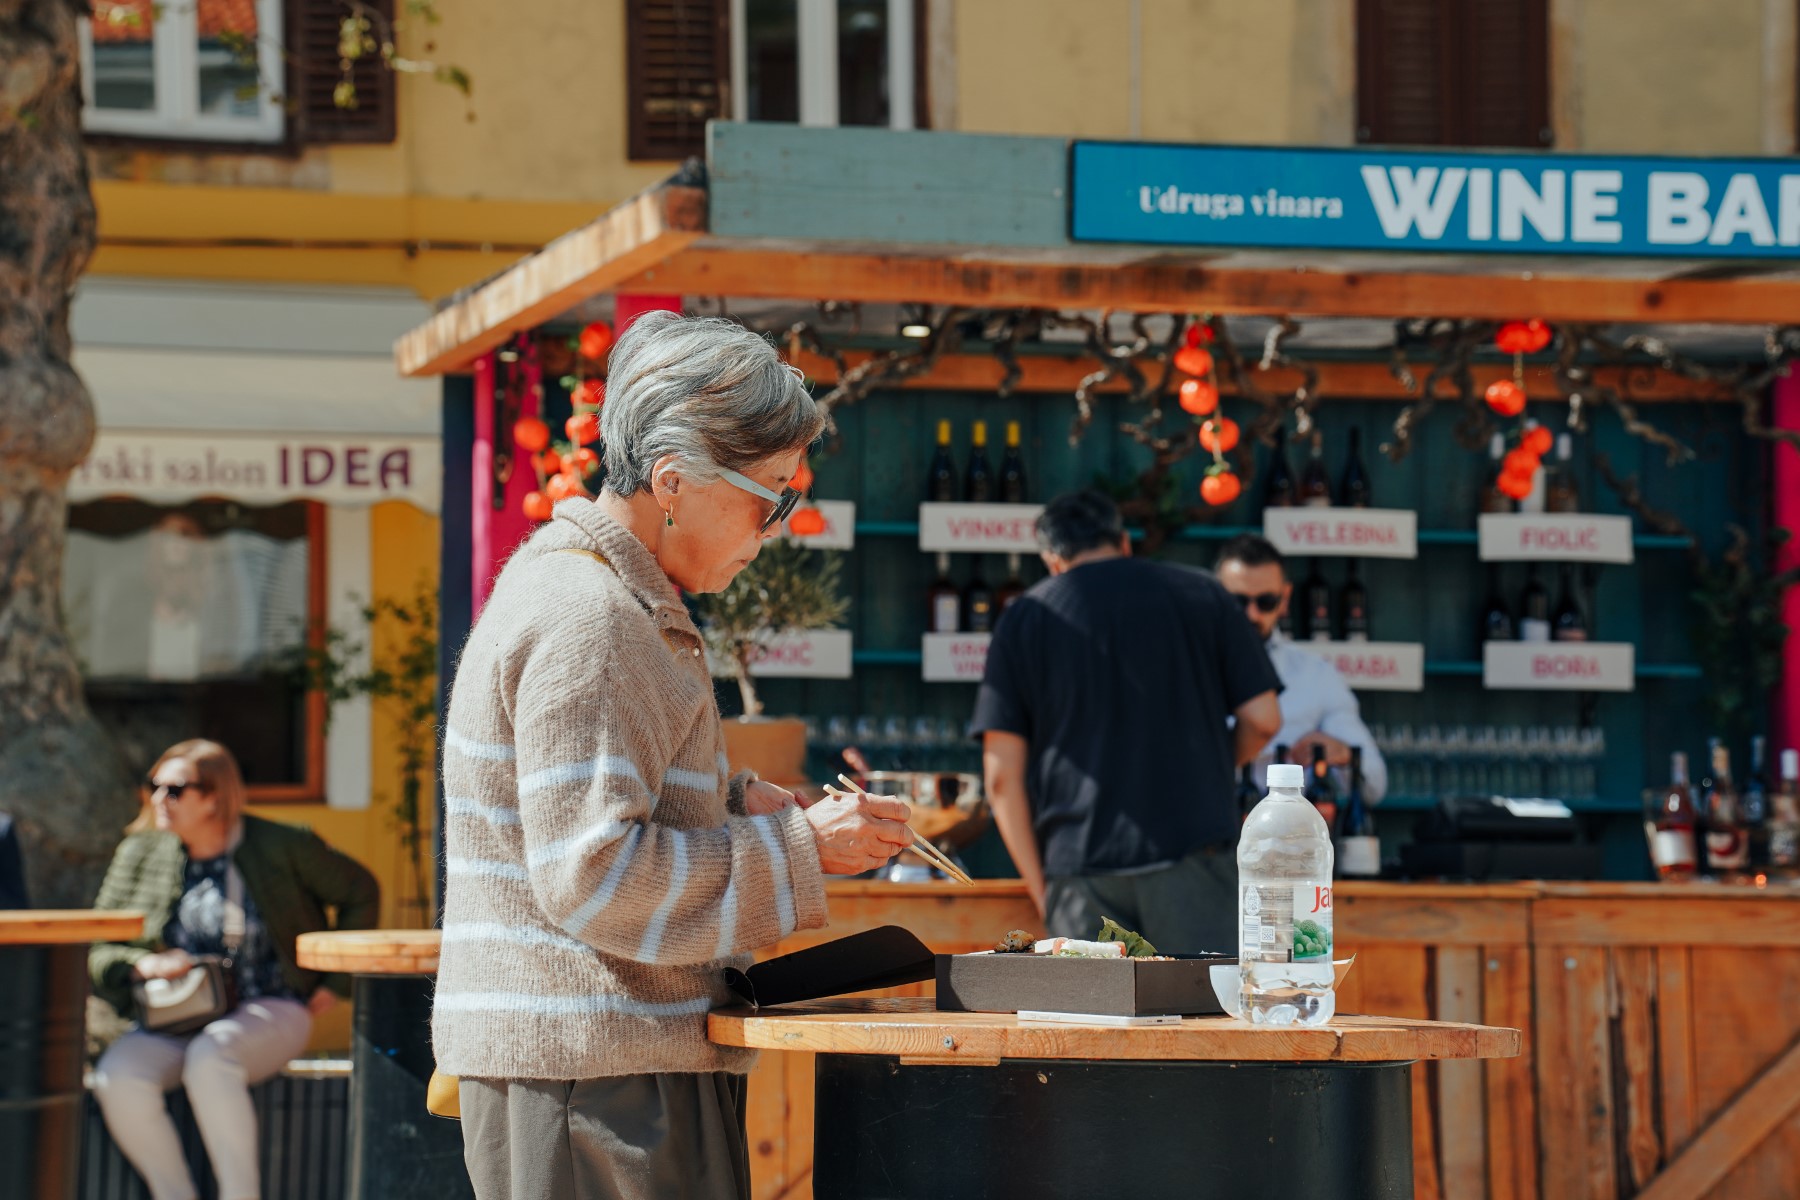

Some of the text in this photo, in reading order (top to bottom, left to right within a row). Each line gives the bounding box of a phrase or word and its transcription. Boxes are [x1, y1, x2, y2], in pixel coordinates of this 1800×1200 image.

[1138, 183, 1344, 220] Udruga vinara
[1360, 165, 1622, 243] WINE
[77, 444, 412, 490] rski salon IDEA
[1285, 520, 1398, 546] VELEBNA
[950, 641, 989, 658] KRA
[1322, 653, 1400, 679] RABA
[1530, 655, 1602, 679] BORA
